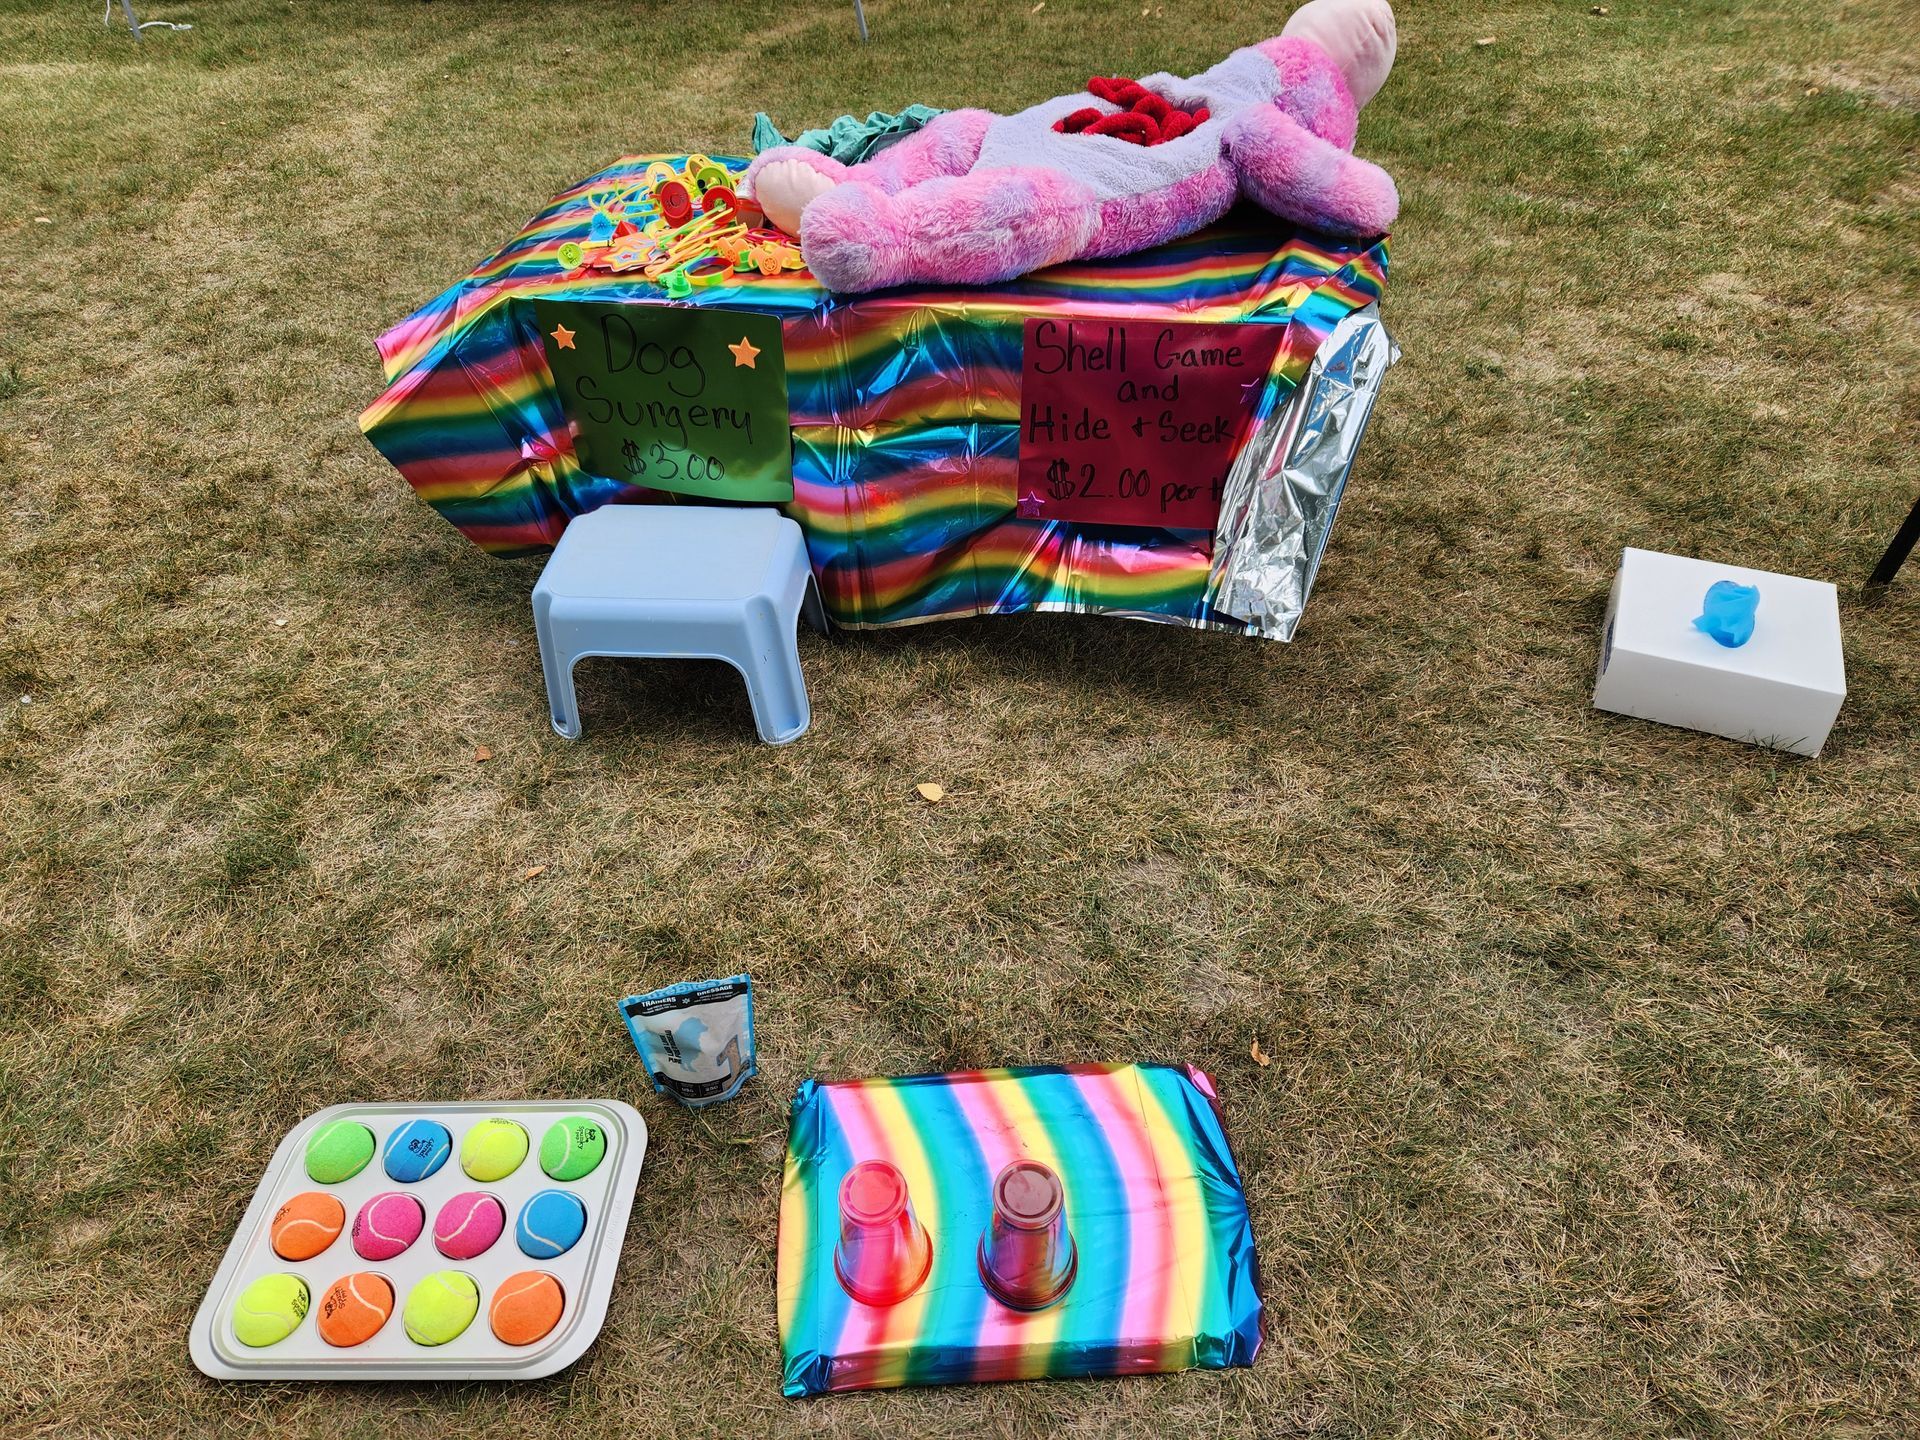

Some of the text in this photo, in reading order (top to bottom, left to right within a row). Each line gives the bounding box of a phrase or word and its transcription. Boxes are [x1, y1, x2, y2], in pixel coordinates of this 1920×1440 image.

[601, 313, 706, 398] Dog
[1034, 320, 1245, 374] Shell Game
[575, 375, 753, 452] Surgery
[1117, 374, 1180, 403] and
[1028, 403, 1111, 443] Hide
[1158, 410, 1235, 444] Seek
[621, 438, 725, 481] $3.00
[1046, 457, 1150, 501] $2.00
[1160, 481, 1204, 514] per
